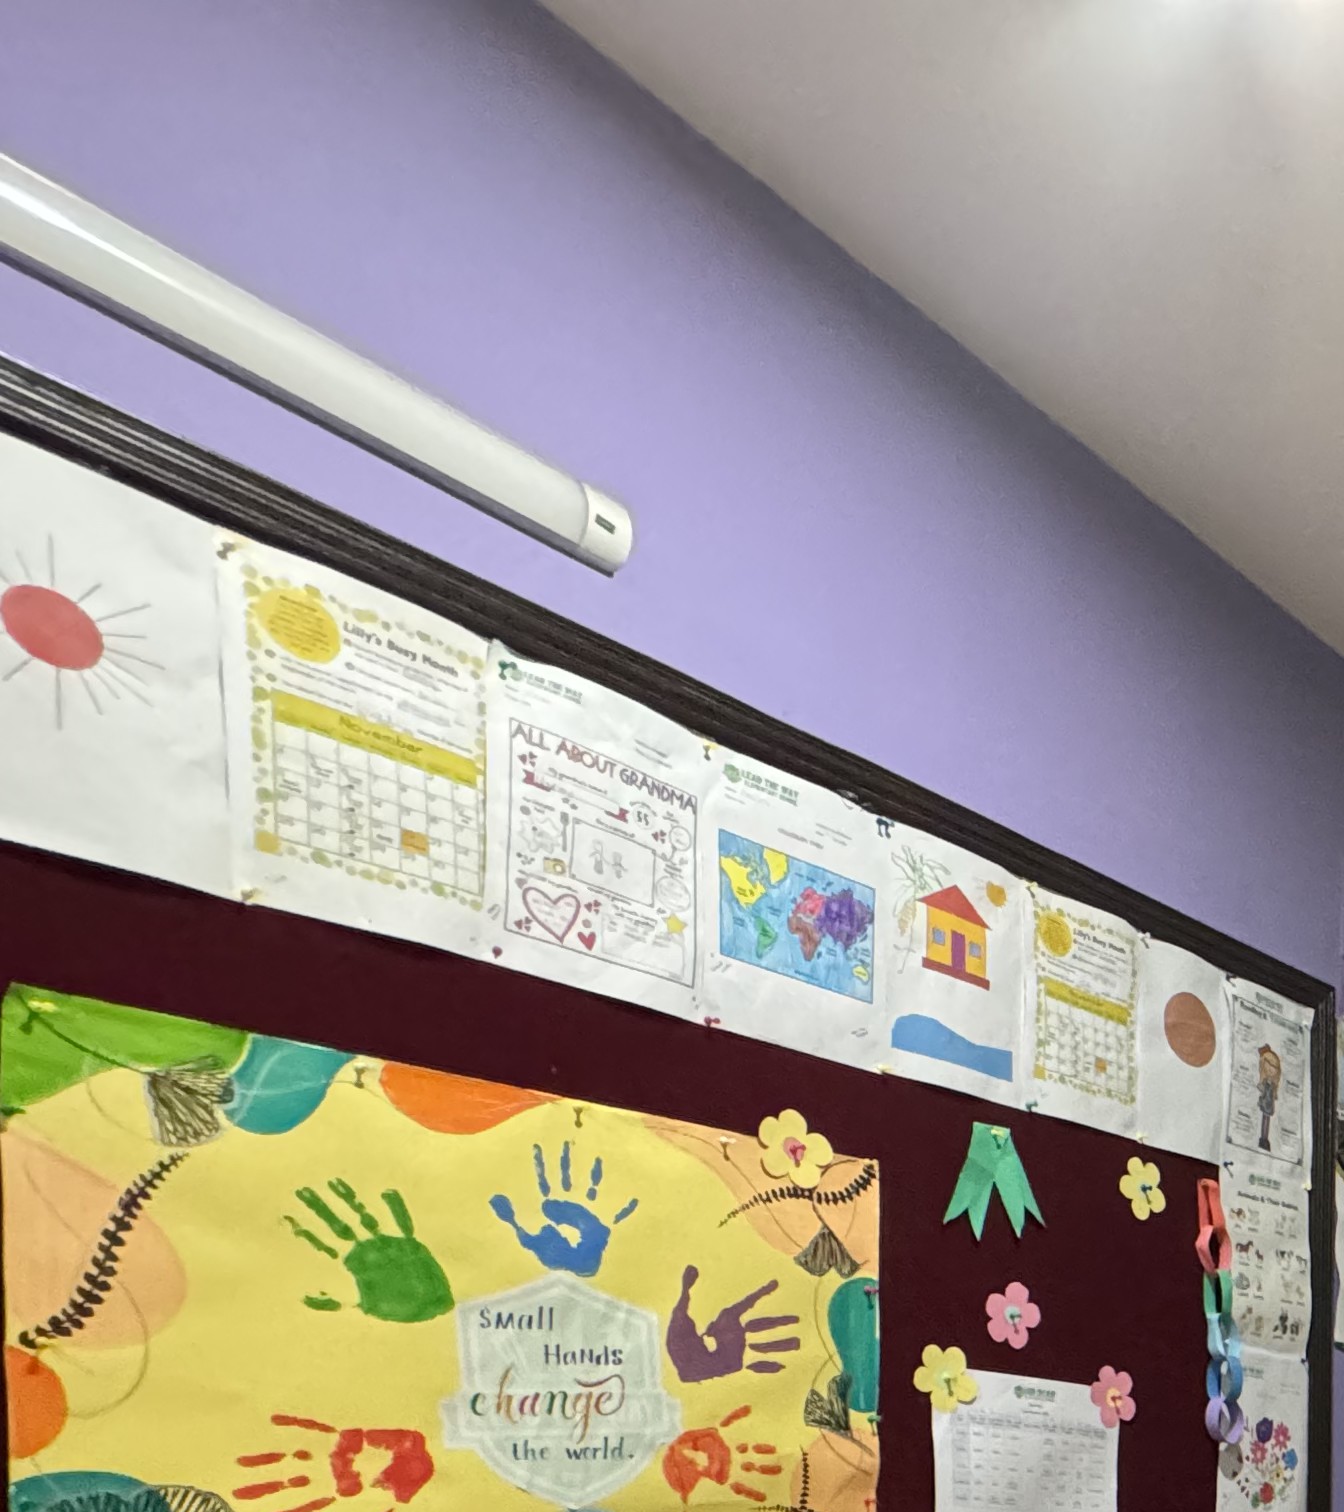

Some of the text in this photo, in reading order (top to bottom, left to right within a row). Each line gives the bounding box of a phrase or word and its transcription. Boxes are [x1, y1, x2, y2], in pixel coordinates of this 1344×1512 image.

[343, 620, 382, 646] Lilly's
[387, 639, 418, 661] Busy
[422, 653, 459, 678] Month
[338, 715, 423, 753] November
[512, 722, 550, 751] ALL
[556, 737, 616, 778] ABOUT
[619, 768, 696, 815] GRANDMA
[765, 778, 779, 791] THE
[781, 785, 799, 798] WAY
[470, 1364, 626, 1445] change
[512, 1436, 635, 1462] the world.
